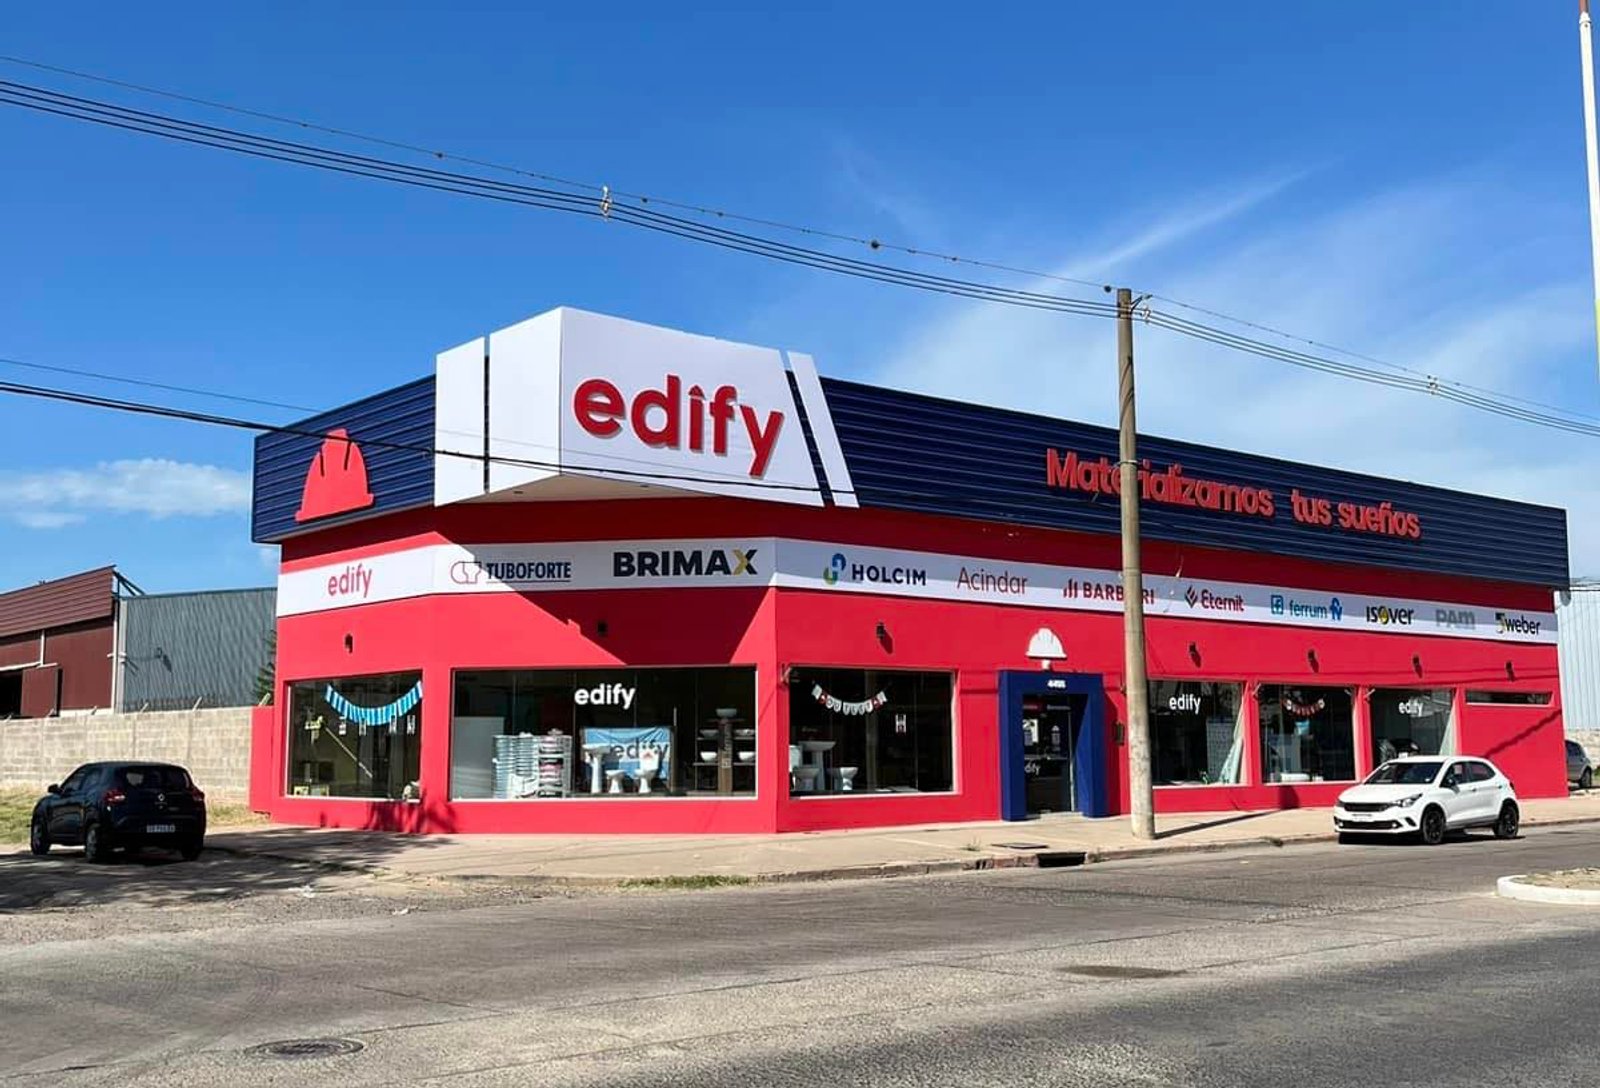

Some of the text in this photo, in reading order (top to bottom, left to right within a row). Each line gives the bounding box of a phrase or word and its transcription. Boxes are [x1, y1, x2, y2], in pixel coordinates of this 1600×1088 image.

[573, 374, 785, 479] edify
[1291, 488, 1332, 525] tus
[1338, 502, 1421, 538] sueños
[486, 561, 571, 580] TUBOFORTE
[613, 549, 758, 577] BRIMAX
[851, 563, 926, 586] HOLCIM
[327, 562, 373, 598] edify
[957, 566, 1029, 594] Acindar
[1082, 581, 1155, 604] BARBRI
[1200, 589, 1245, 612] Eternit
[1289, 599, 1328, 618] ferrum
[1504, 614, 1541, 636] weber
[574, 682, 636, 710] edify
[1168, 693, 1201, 715] edify
